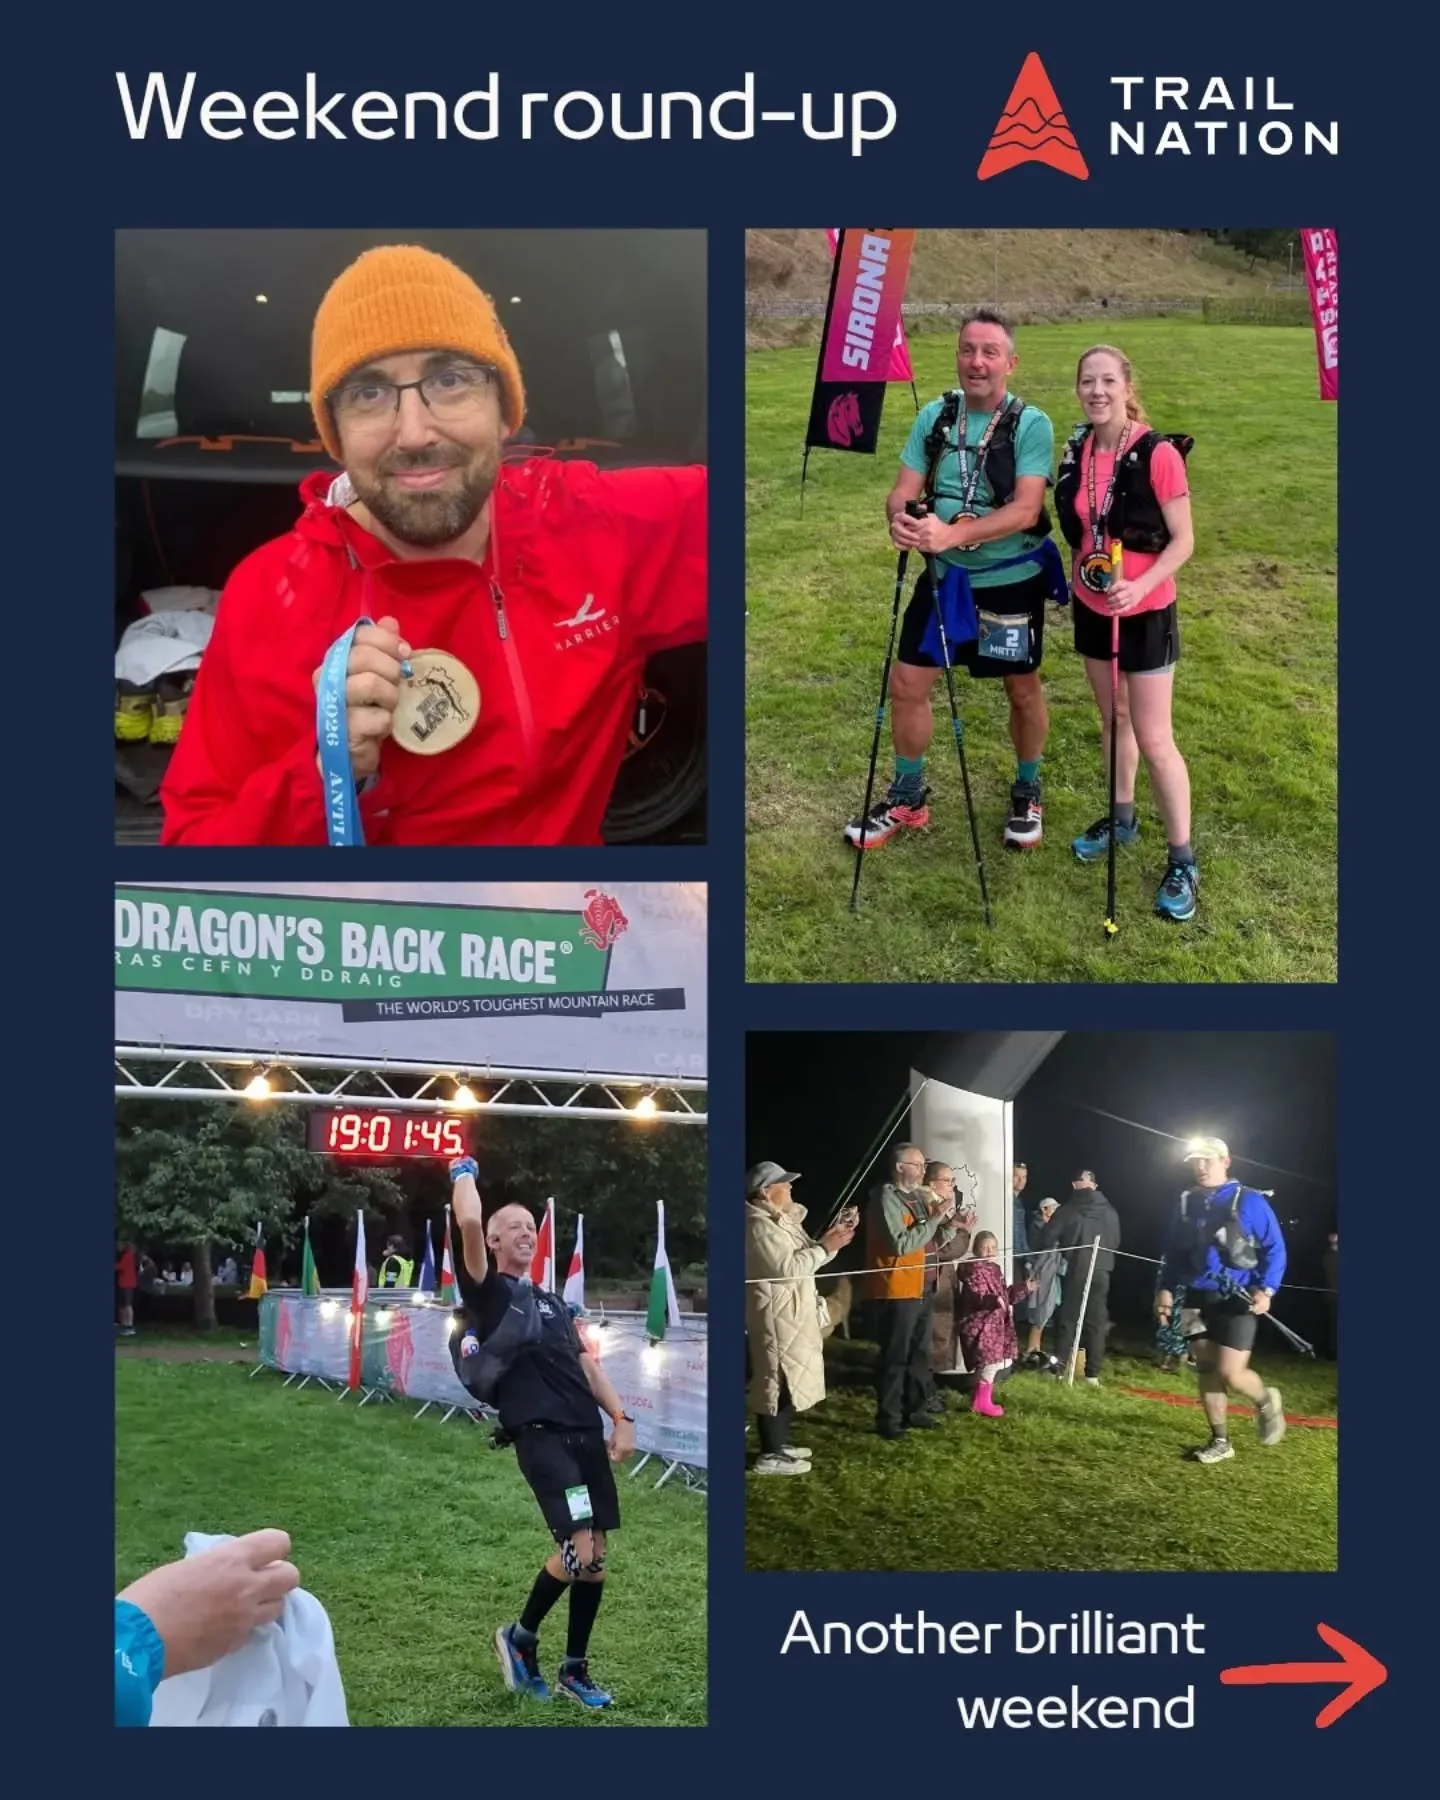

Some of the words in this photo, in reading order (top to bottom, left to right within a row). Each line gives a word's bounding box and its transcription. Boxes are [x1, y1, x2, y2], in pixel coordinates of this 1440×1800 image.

[842, 234, 891, 371] SIRONA
[554, 615, 620, 651] HARRIER
[1006, 628, 1020, 648] 2
[325, 689, 340, 747] 2026
[410, 699, 450, 742] LAP
[329, 771, 346, 835] ANTI
[114, 899, 326, 965] DRAGON'S
[341, 921, 447, 976] BACK
[181, 957, 252, 976] CEFN
[270, 965, 283, 978] Y
[301, 967, 402, 988] DDRAIG
[375, 1001, 404, 1016] THE
[405, 999, 471, 1014] WORLD'S
[473, 996, 544, 1013] TOUGHEST
[547, 994, 619, 1010] MOUNTAIN
[622, 993, 657, 1008] RACE
